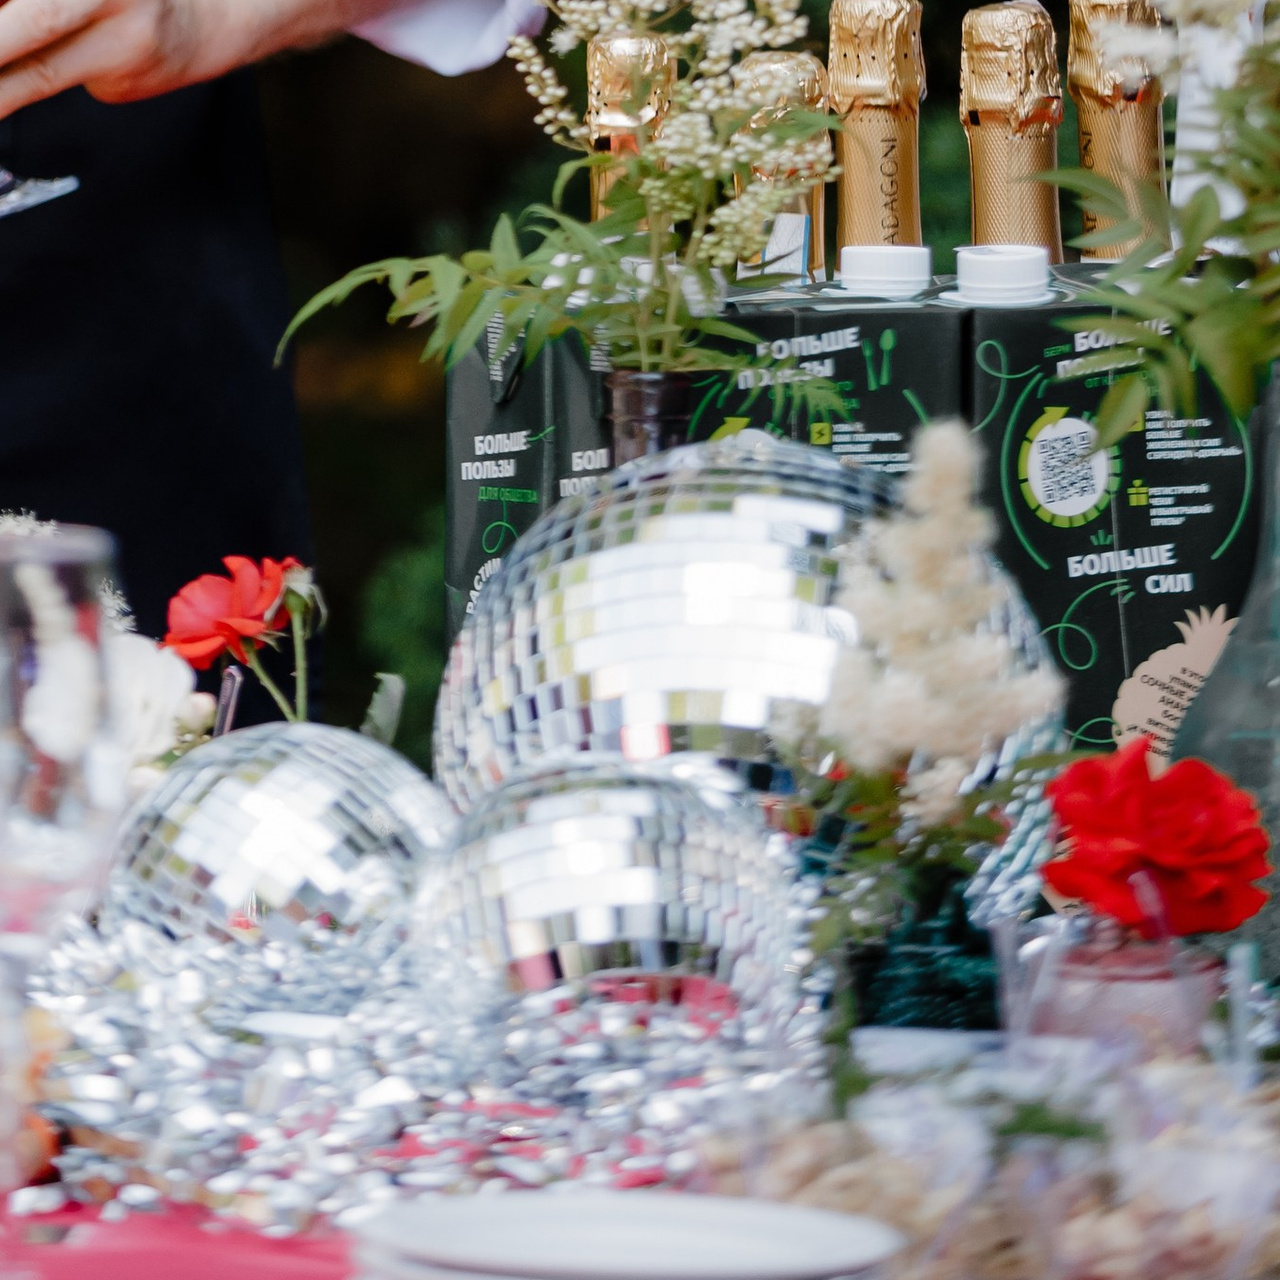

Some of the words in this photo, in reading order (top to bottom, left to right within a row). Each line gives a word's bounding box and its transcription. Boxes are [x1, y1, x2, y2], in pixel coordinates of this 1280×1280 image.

[473, 429, 533, 456] БОЛЬШЕ
[460, 458, 518, 481] ПОЛЬЗЫ
[1066, 542, 1179, 578] БОЛЬШЕ
[1144, 572, 1195, 594] СИЛ
[1140, 674, 1187, 699] СОЧНЫЕ
